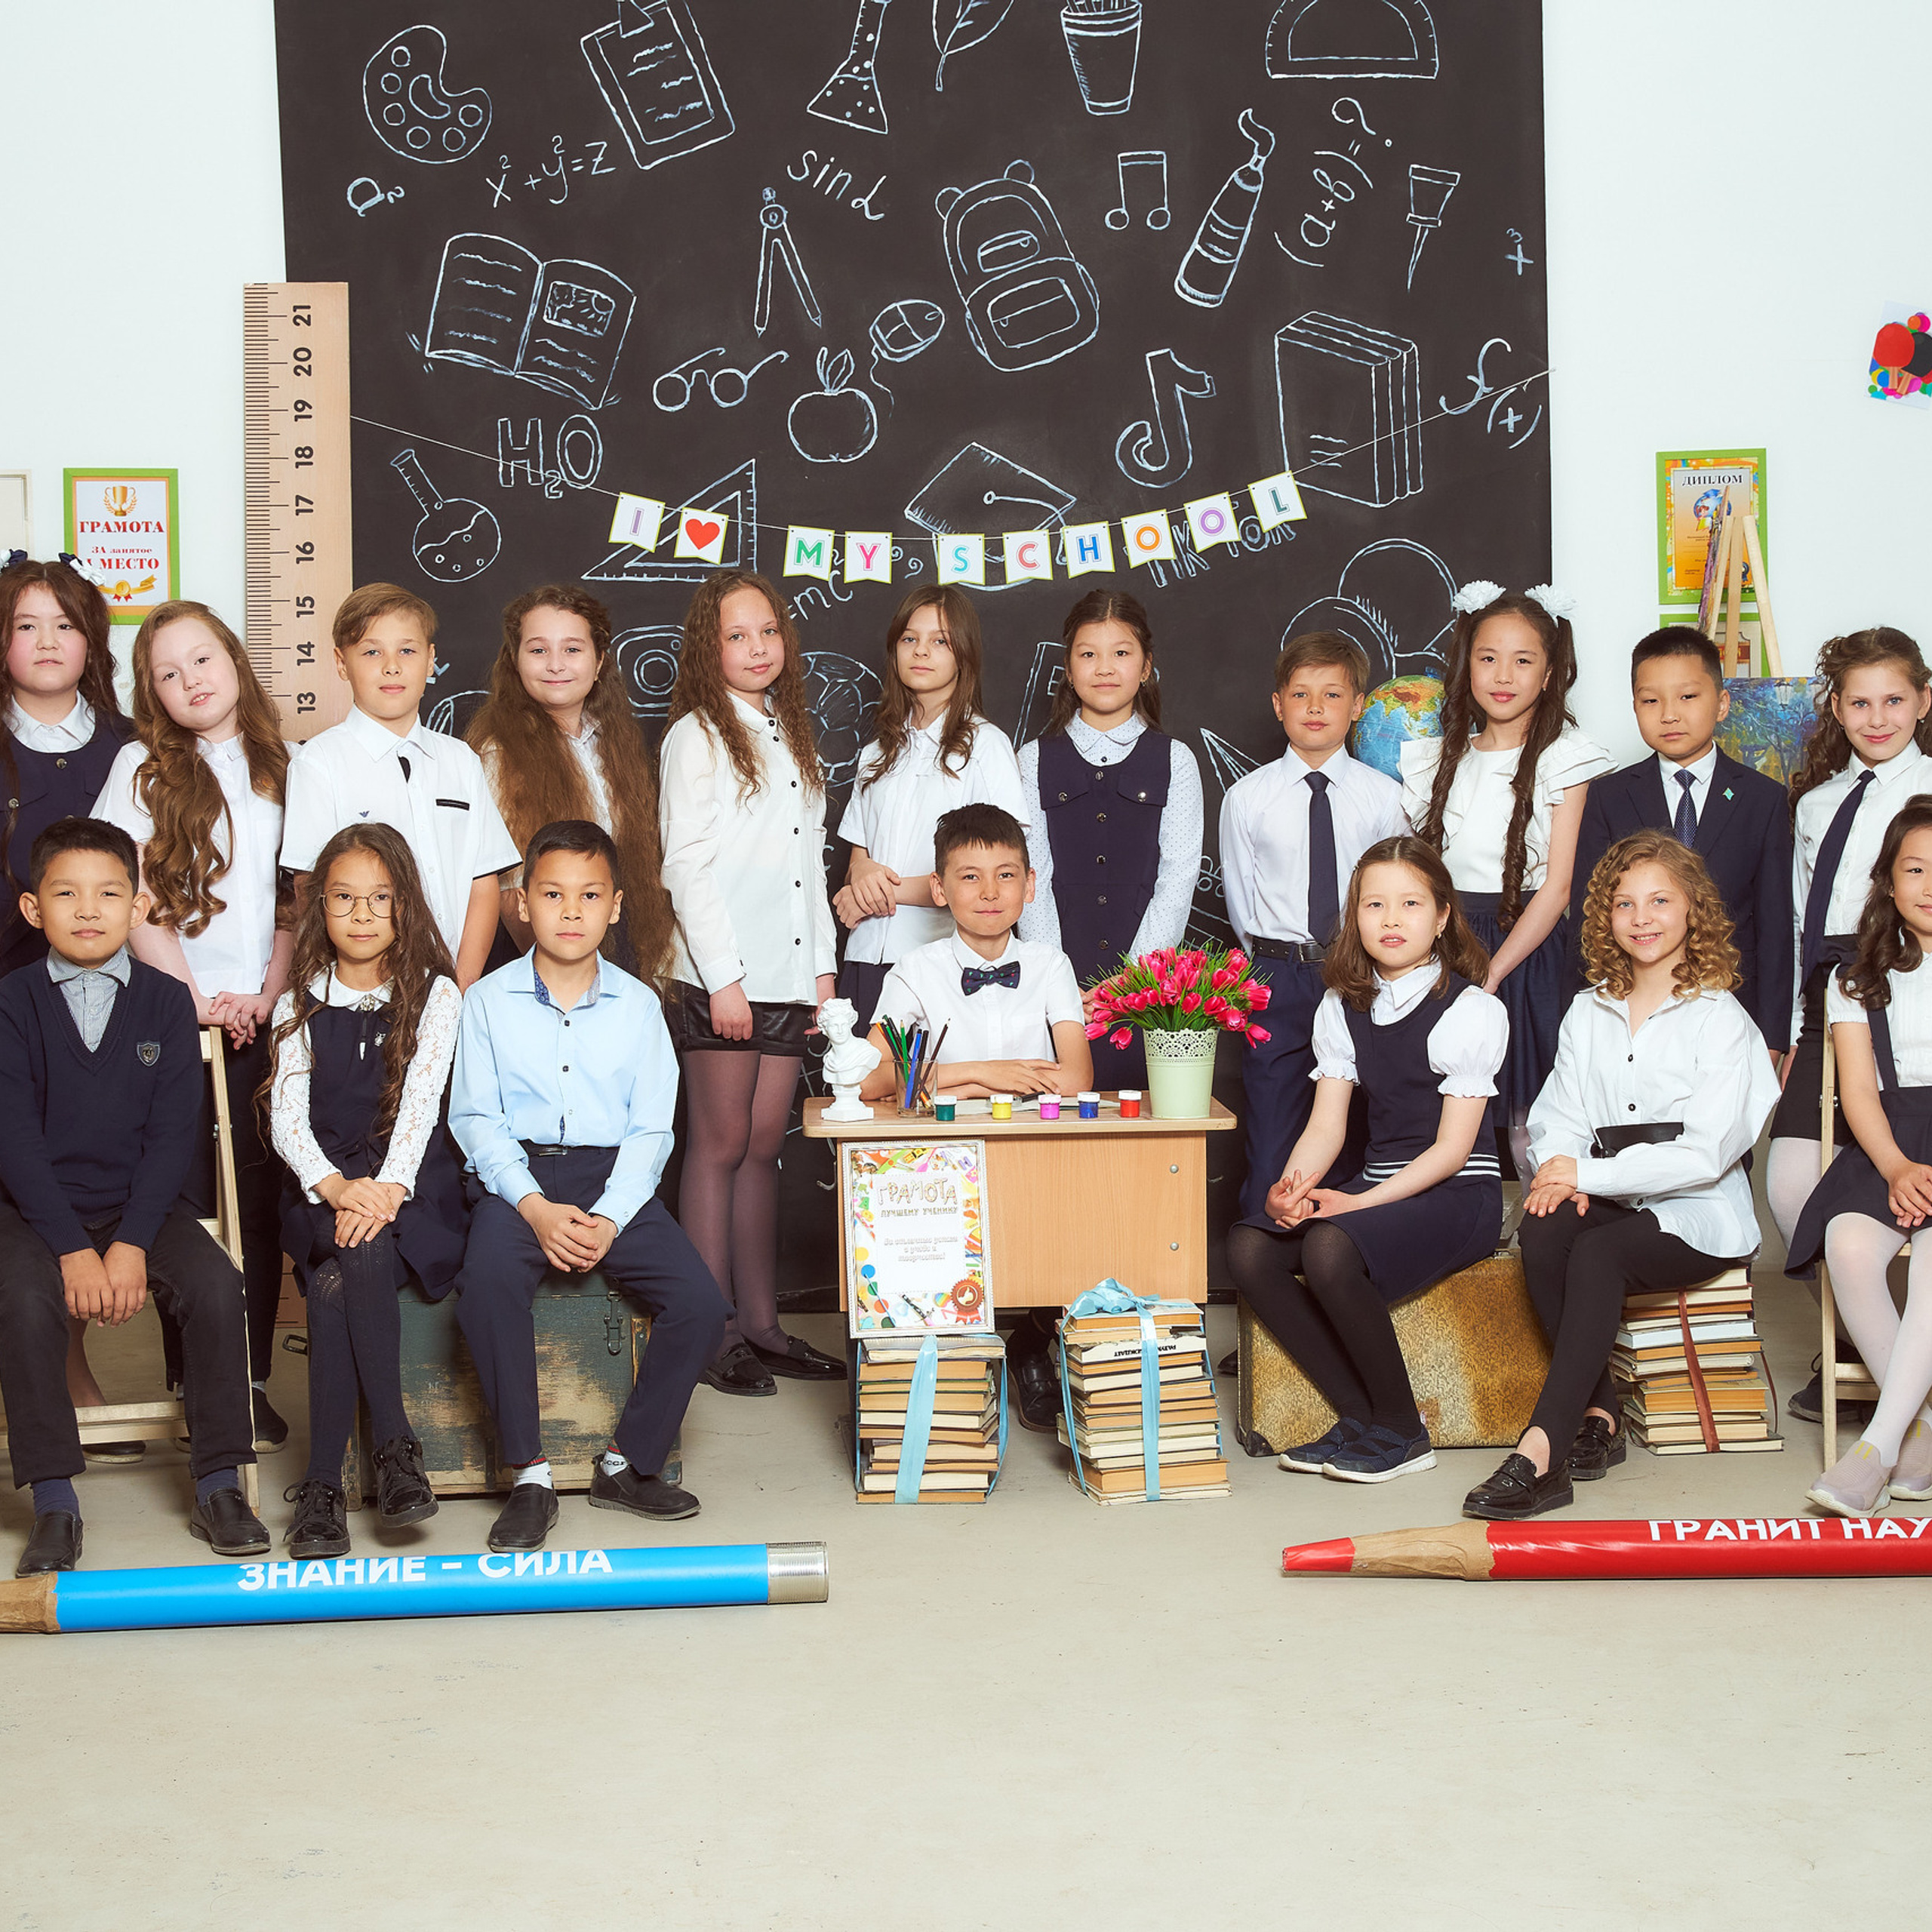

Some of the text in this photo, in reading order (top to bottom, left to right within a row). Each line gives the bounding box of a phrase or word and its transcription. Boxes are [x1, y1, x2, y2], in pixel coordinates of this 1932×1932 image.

[293, 305, 311, 327] 21
[293, 346, 312, 377] 20
[294, 399, 312, 422] 19
[294, 445, 314, 469] 18
[1681, 475, 1743, 486] ДИПЛОМ
[295, 494, 314, 516] 17
[79, 521, 164, 533] ГРАМОТА
[794, 537, 881, 571] MY
[952, 487, 1290, 574] SCHOOL
[91, 546, 106, 554] ЗА
[295, 541, 315, 565] 16
[100, 558, 159, 570] МЕСТО
[296, 595, 315, 618] 15
[297, 641, 315, 666] 14
[297, 691, 316, 715] 13
[878, 1178, 958, 1206] ГРАМОТА
[881, 1206, 958, 1217] ЛУЧШЕМУ УЧЕНИКУ
[1647, 1518, 1932, 1541] ГРАНИТ НАУ
[237, 1555, 427, 1592] ЗНАНИЕ
[477, 1549, 614, 1578] СИЛА
